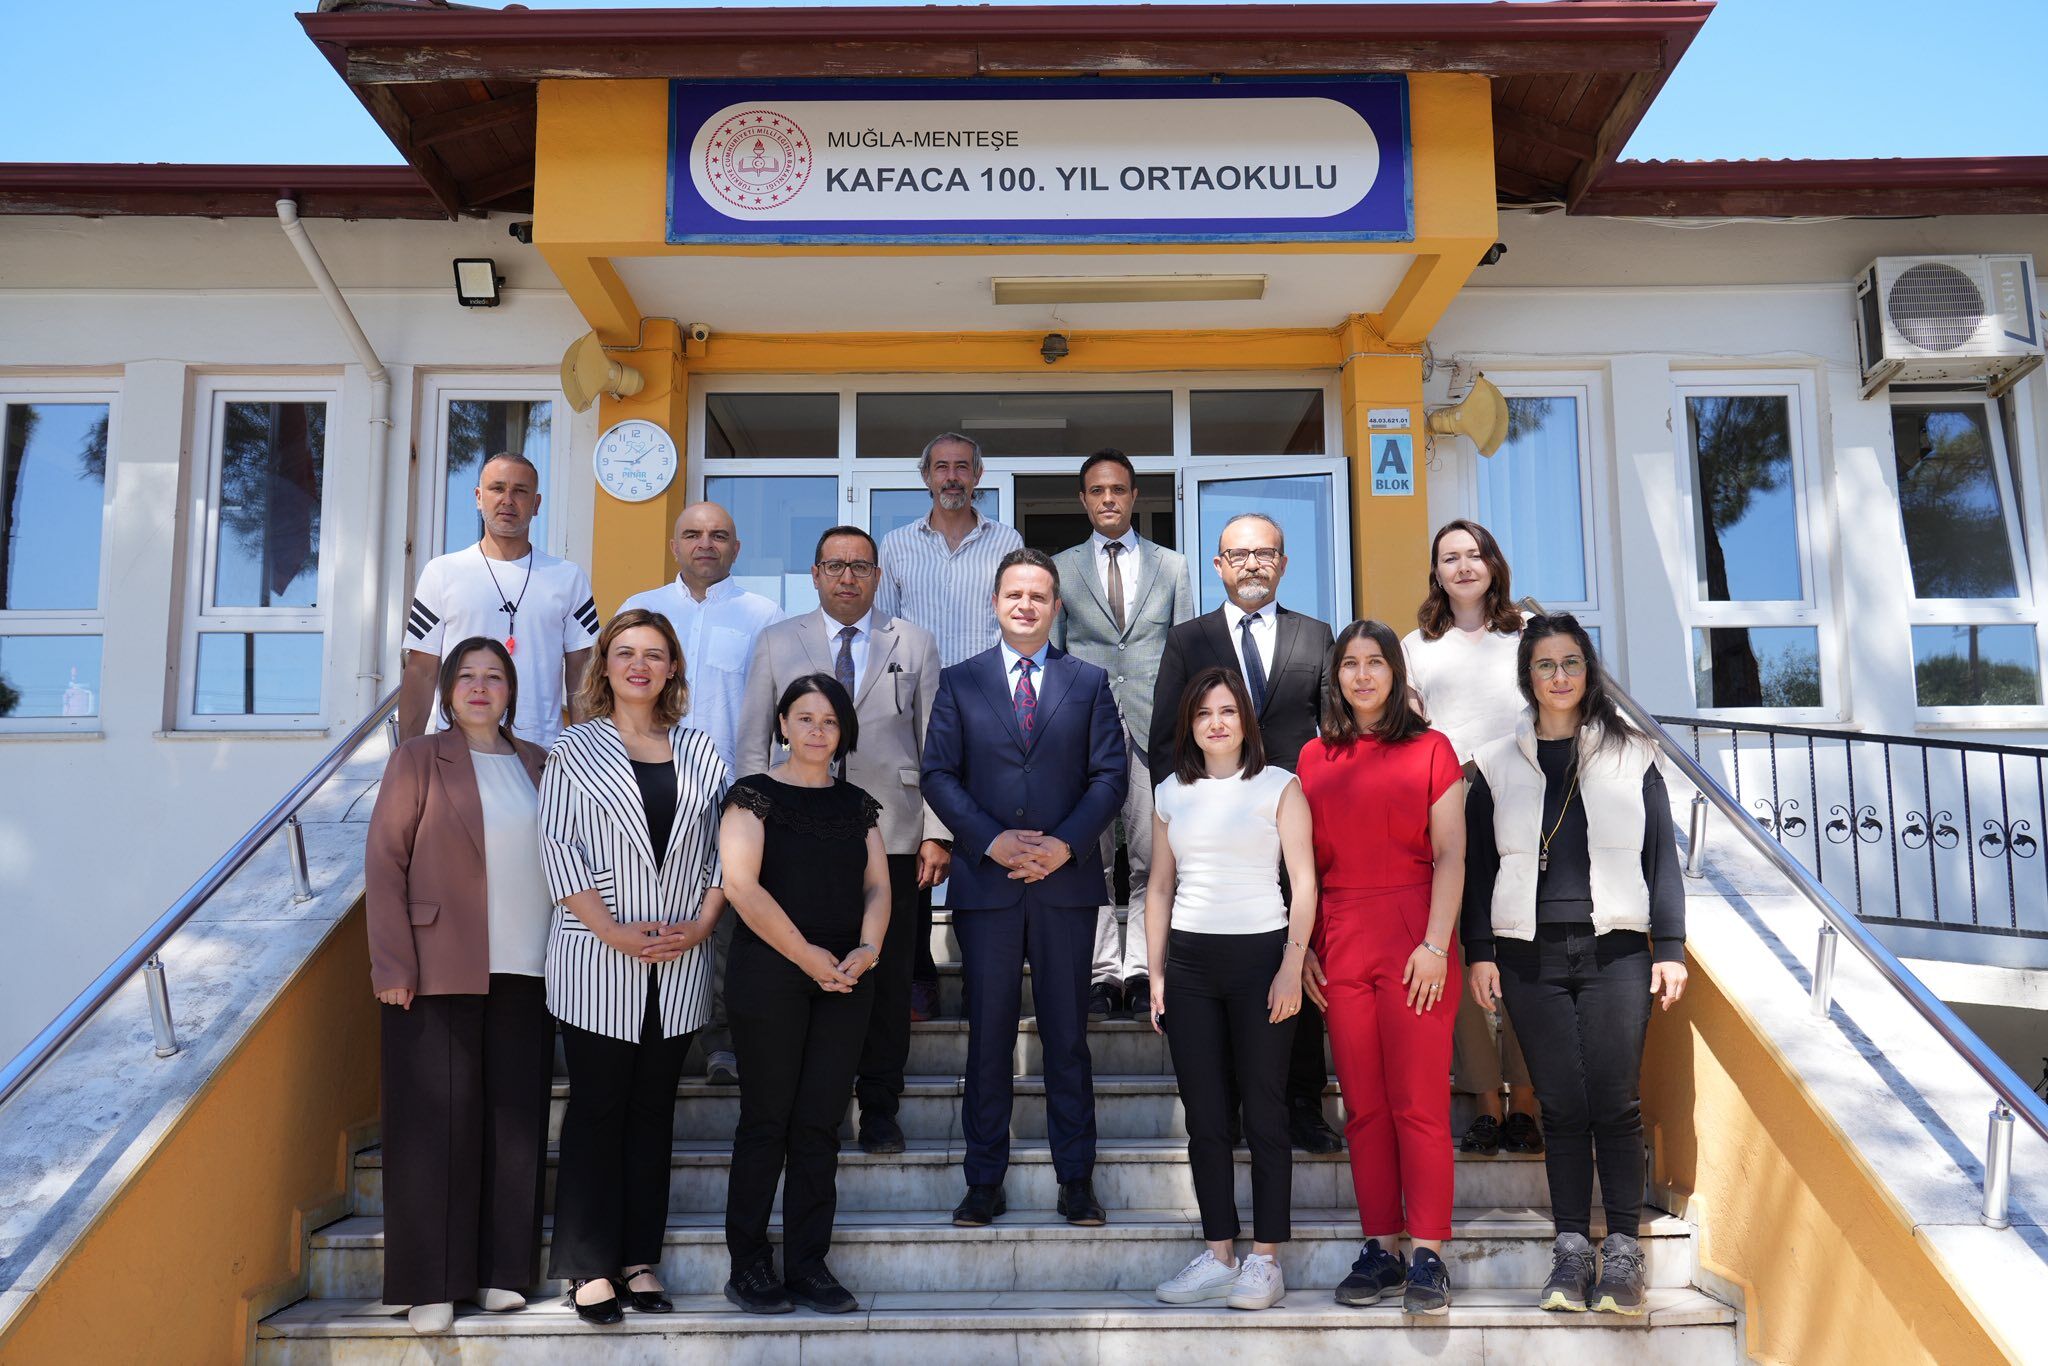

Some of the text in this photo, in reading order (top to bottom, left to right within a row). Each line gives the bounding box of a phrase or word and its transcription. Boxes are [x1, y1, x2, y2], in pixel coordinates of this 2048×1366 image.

[828, 126, 1019, 152] MUĞLA-MENTEŞE
[826, 165, 1337, 192] KAFACA 100. YIL ORTAOKULU
[619, 434, 626, 442] 11
[631, 429, 641, 438] 12
[650, 434, 653, 442] 1
[607, 444, 618, 453] 10
[658, 444, 665, 453] 2
[1376, 439, 1407, 474] A
[602, 457, 609, 466] 9
[662, 457, 669, 466] 3
[606, 473, 614, 481] 8
[656, 473, 664, 481] 4
[617, 482, 624, 491] 7
[645, 482, 653, 491] 5
[1375, 479, 1410, 490] BLOK
[631, 486, 638, 494] 6
